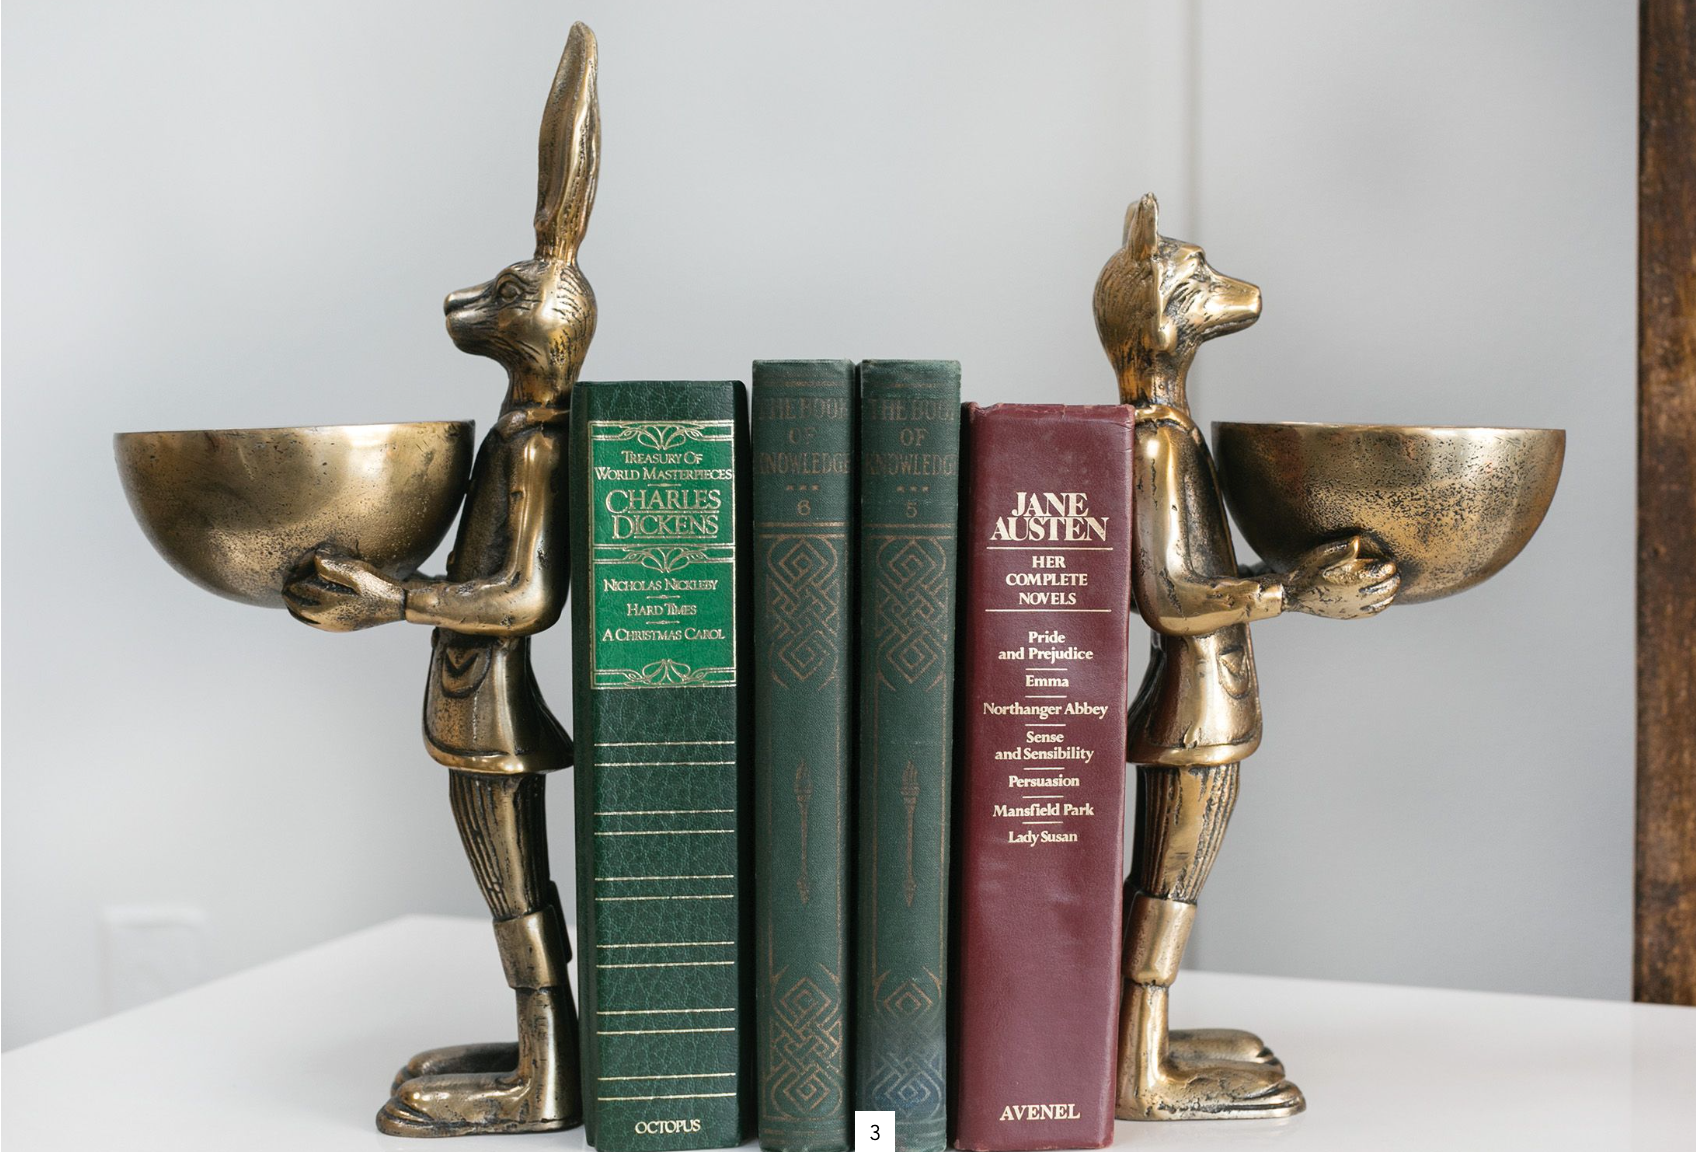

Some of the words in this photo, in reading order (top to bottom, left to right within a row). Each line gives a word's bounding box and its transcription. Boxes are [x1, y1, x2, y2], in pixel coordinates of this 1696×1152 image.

[788, 427, 817, 445] OF
[899, 427, 929, 447] OF
[605, 489, 722, 514] CHARLES
[796, 500, 812, 516] 6
[1011, 491, 1089, 517] JANE
[905, 502, 918, 518] 5
[611, 514, 719, 540] DICKENS
[989, 516, 1110, 542] AUSTEN
[1032, 555, 1066, 569] HER
[1005, 573, 1088, 586] COMPLETE
[1019, 592, 1077, 605] NOVELS
[602, 630, 615, 642] A
[1028, 630, 1066, 644] Pride
[998, 647, 1025, 660] and
[1028, 646, 1094, 664] Prejudice
[1025, 674, 1070, 688] Emma
[983, 702, 1062, 719] Northanger
[1064, 702, 1109, 719] Abbey
[1026, 730, 1065, 743] Sense
[994, 747, 1022, 761] and
[1023, 747, 1094, 763] Sensibility
[1008, 774, 1080, 788] Persuasion
[992, 802, 1061, 818] Mansfield
[1063, 803, 1095, 817] Park
[1008, 831, 1040, 847] Lady
[1040, 831, 1078, 843] Susan
[1000, 1104, 1081, 1121] AVENEL
[634, 1119, 701, 1135] OCTOPUS
